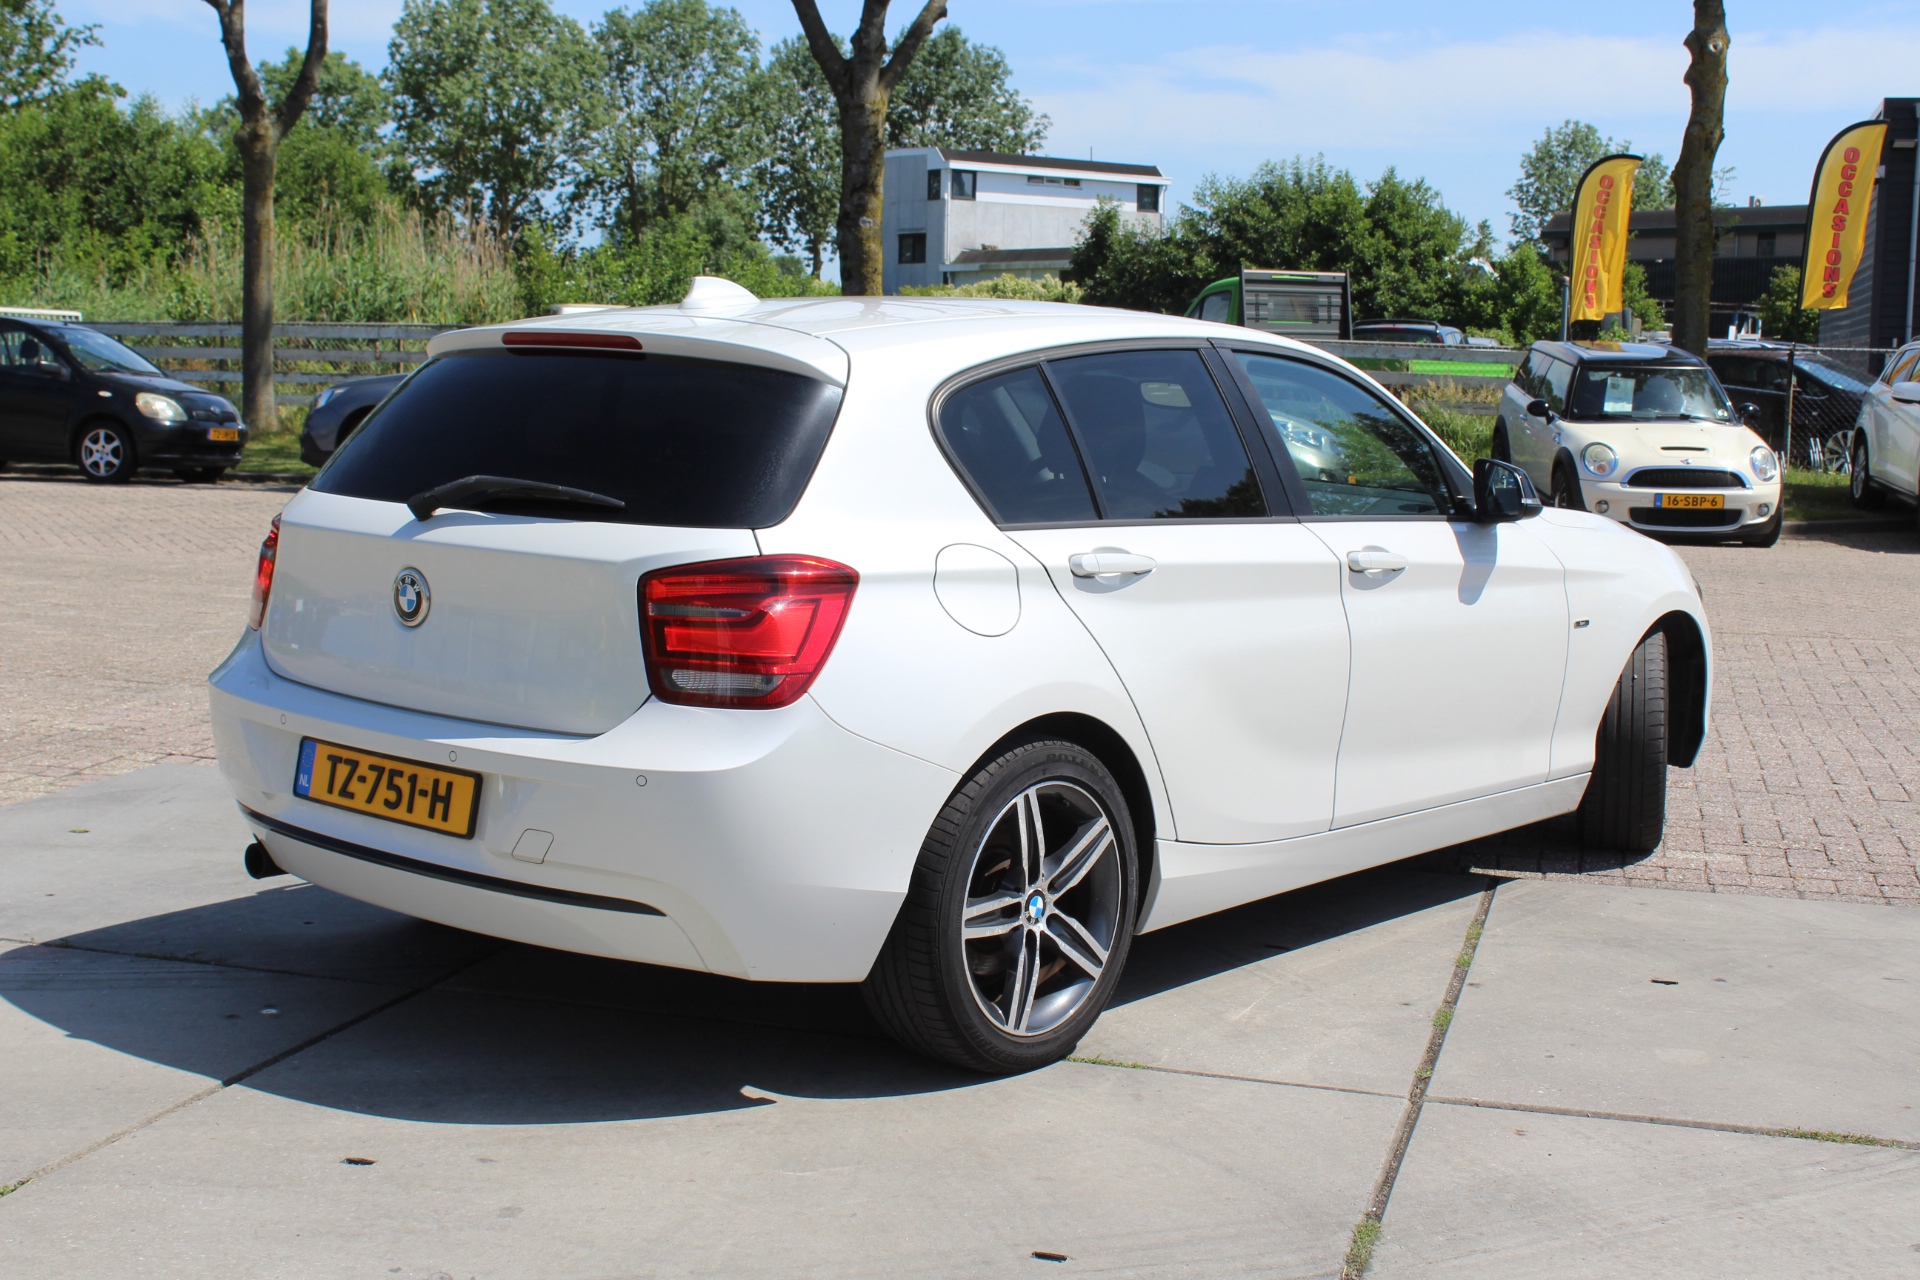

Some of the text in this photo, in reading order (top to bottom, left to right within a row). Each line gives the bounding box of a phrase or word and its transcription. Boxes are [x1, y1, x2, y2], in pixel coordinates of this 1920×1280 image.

[1584, 175, 1614, 309] OCCASIONS
[1822, 147, 1860, 298] OCCASIONS
[1667, 496, 1718, 507] 16-SBP-6
[397, 576, 420, 592] BMW
[299, 773, 309, 787] NL
[327, 754, 453, 823] TZ-751-H
